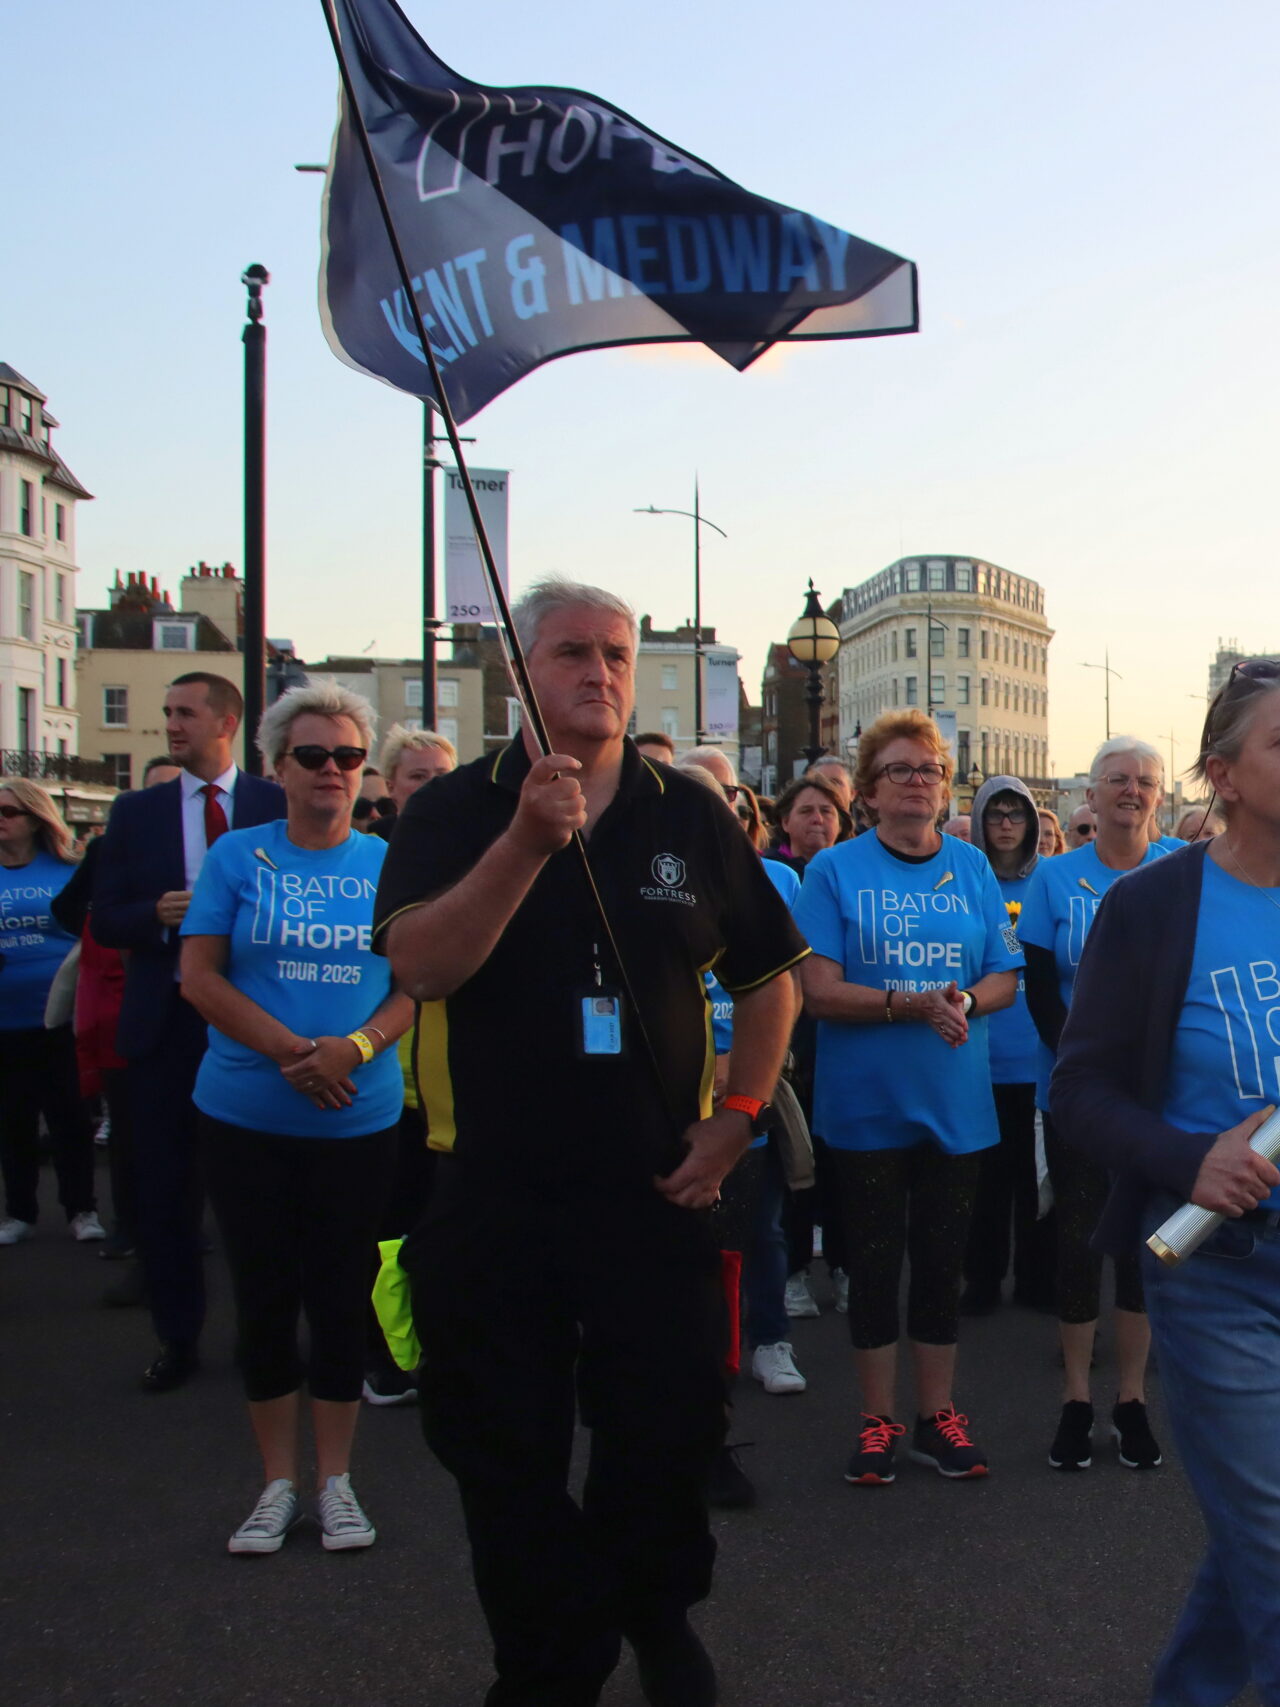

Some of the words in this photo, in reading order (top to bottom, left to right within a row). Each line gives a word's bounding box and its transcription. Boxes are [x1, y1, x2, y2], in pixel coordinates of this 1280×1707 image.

[380, 248, 495, 373] KENT
[505, 233, 549, 320] &
[560, 213, 849, 306] MEDWAY
[450, 605, 480, 617] 250
[0, 886, 53, 901] ATON
[640, 887, 697, 904] FORTRESS
[882, 889, 969, 914] BATON
[283, 896, 326, 920] OF
[281, 919, 373, 951] HOPE
[883, 914, 920, 937] OF
[884, 942, 962, 968] HOPE
[277, 959, 318, 982] TOUR
[321, 963, 362, 985] 2025
[713, 1002, 734, 1020] 202
